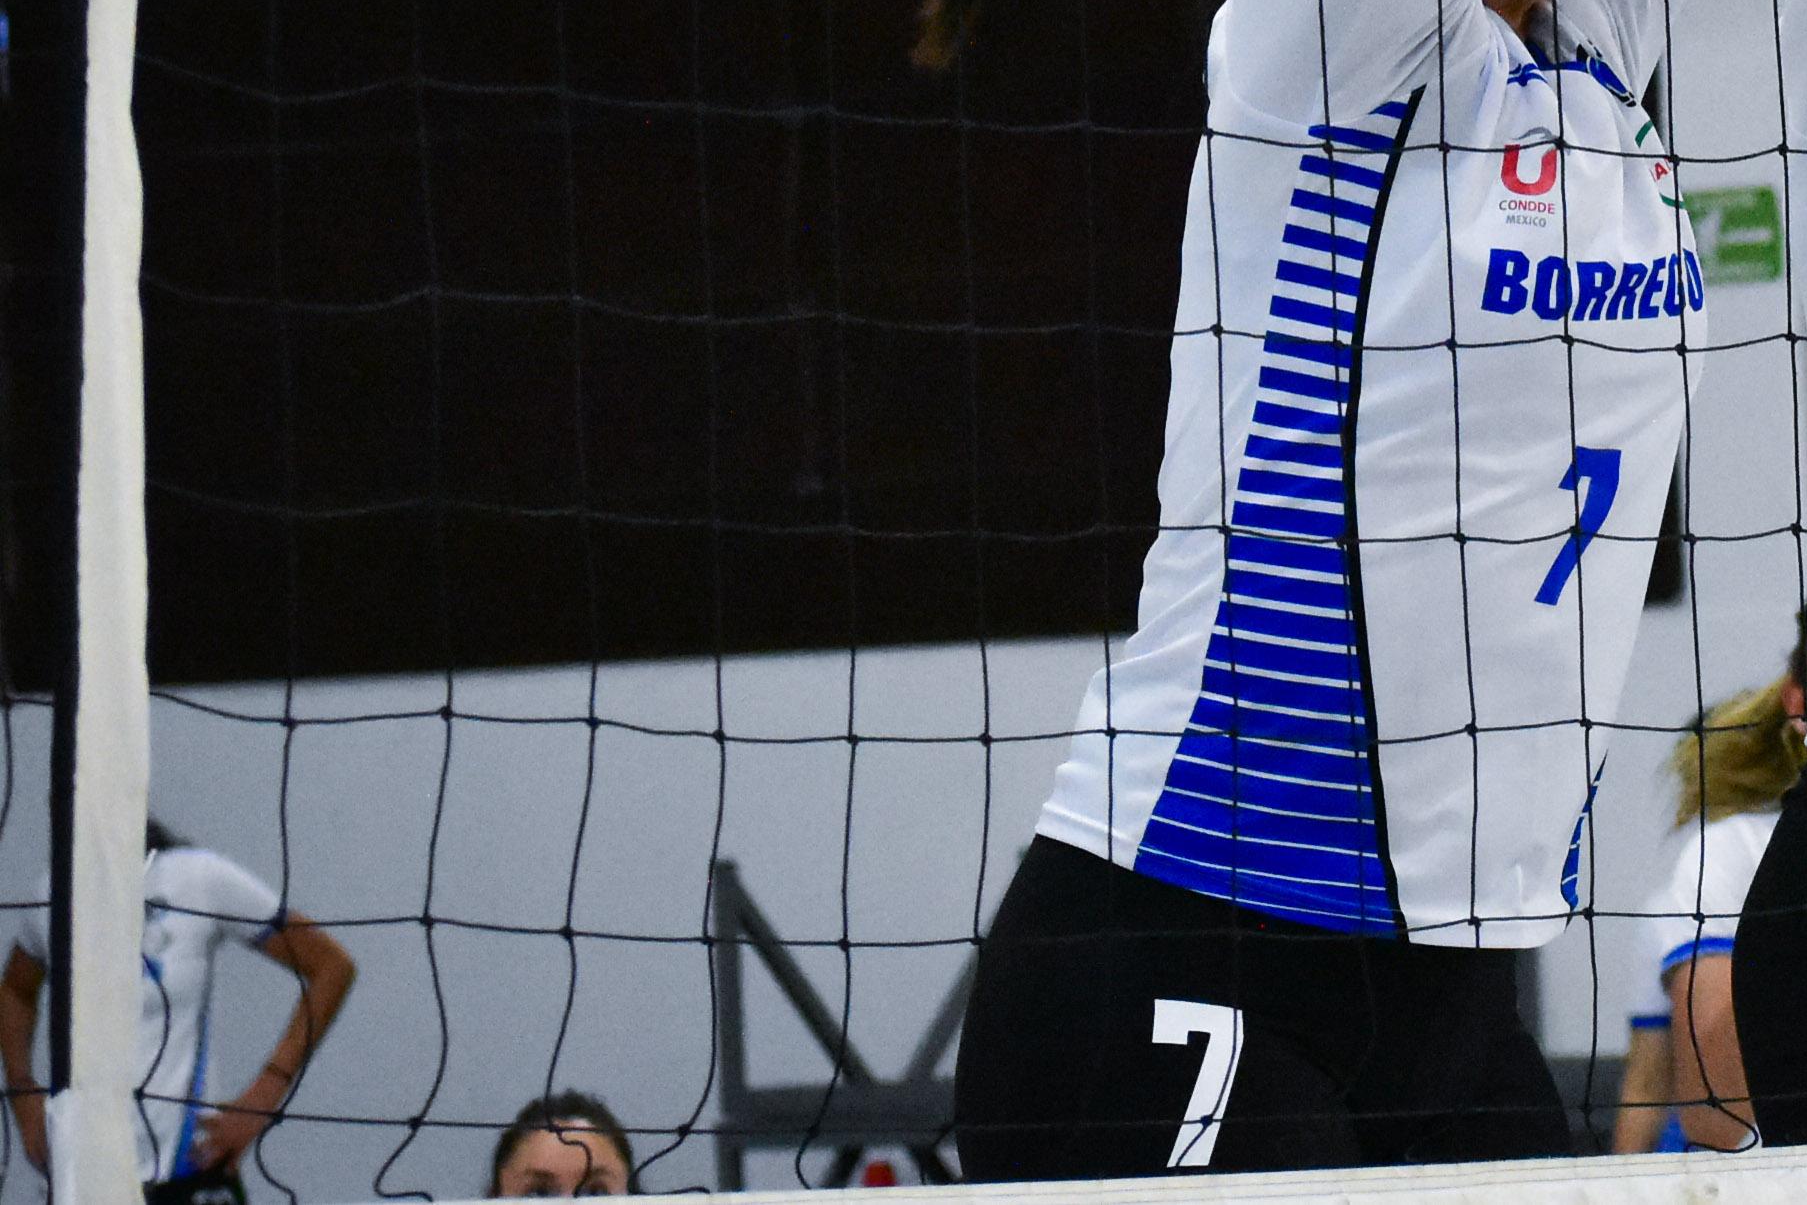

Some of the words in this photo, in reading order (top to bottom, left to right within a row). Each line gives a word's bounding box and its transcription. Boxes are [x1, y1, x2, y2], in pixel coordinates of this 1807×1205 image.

[1498, 199, 1556, 215] CONDDE
[1505, 214, 1547, 228] MEXICO
[1533, 444, 1622, 605] 7
[1151, 998, 1245, 1168] 7
